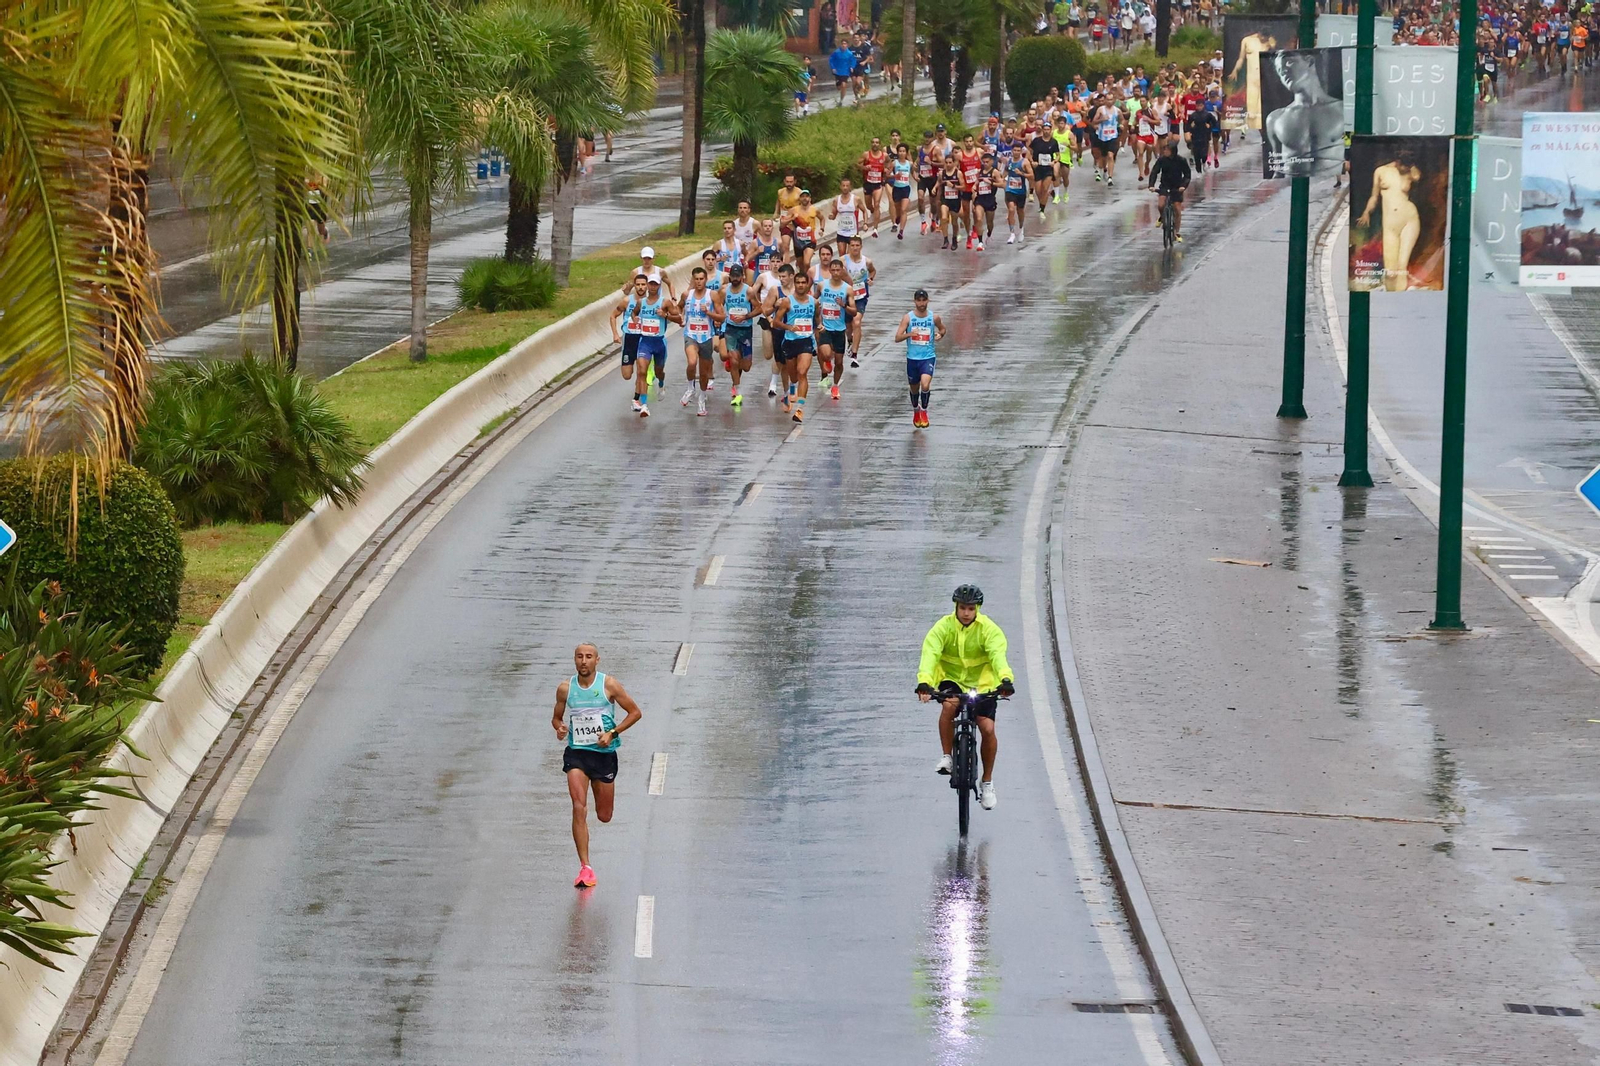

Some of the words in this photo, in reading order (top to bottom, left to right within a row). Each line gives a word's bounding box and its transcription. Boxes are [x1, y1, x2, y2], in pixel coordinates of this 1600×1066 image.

[1388, 64, 1445, 83] DES
[1396, 90, 1436, 108] NU
[1385, 116, 1446, 135] DOS
[1531, 124, 1541, 133] El
[574, 725, 602, 736] 11344
